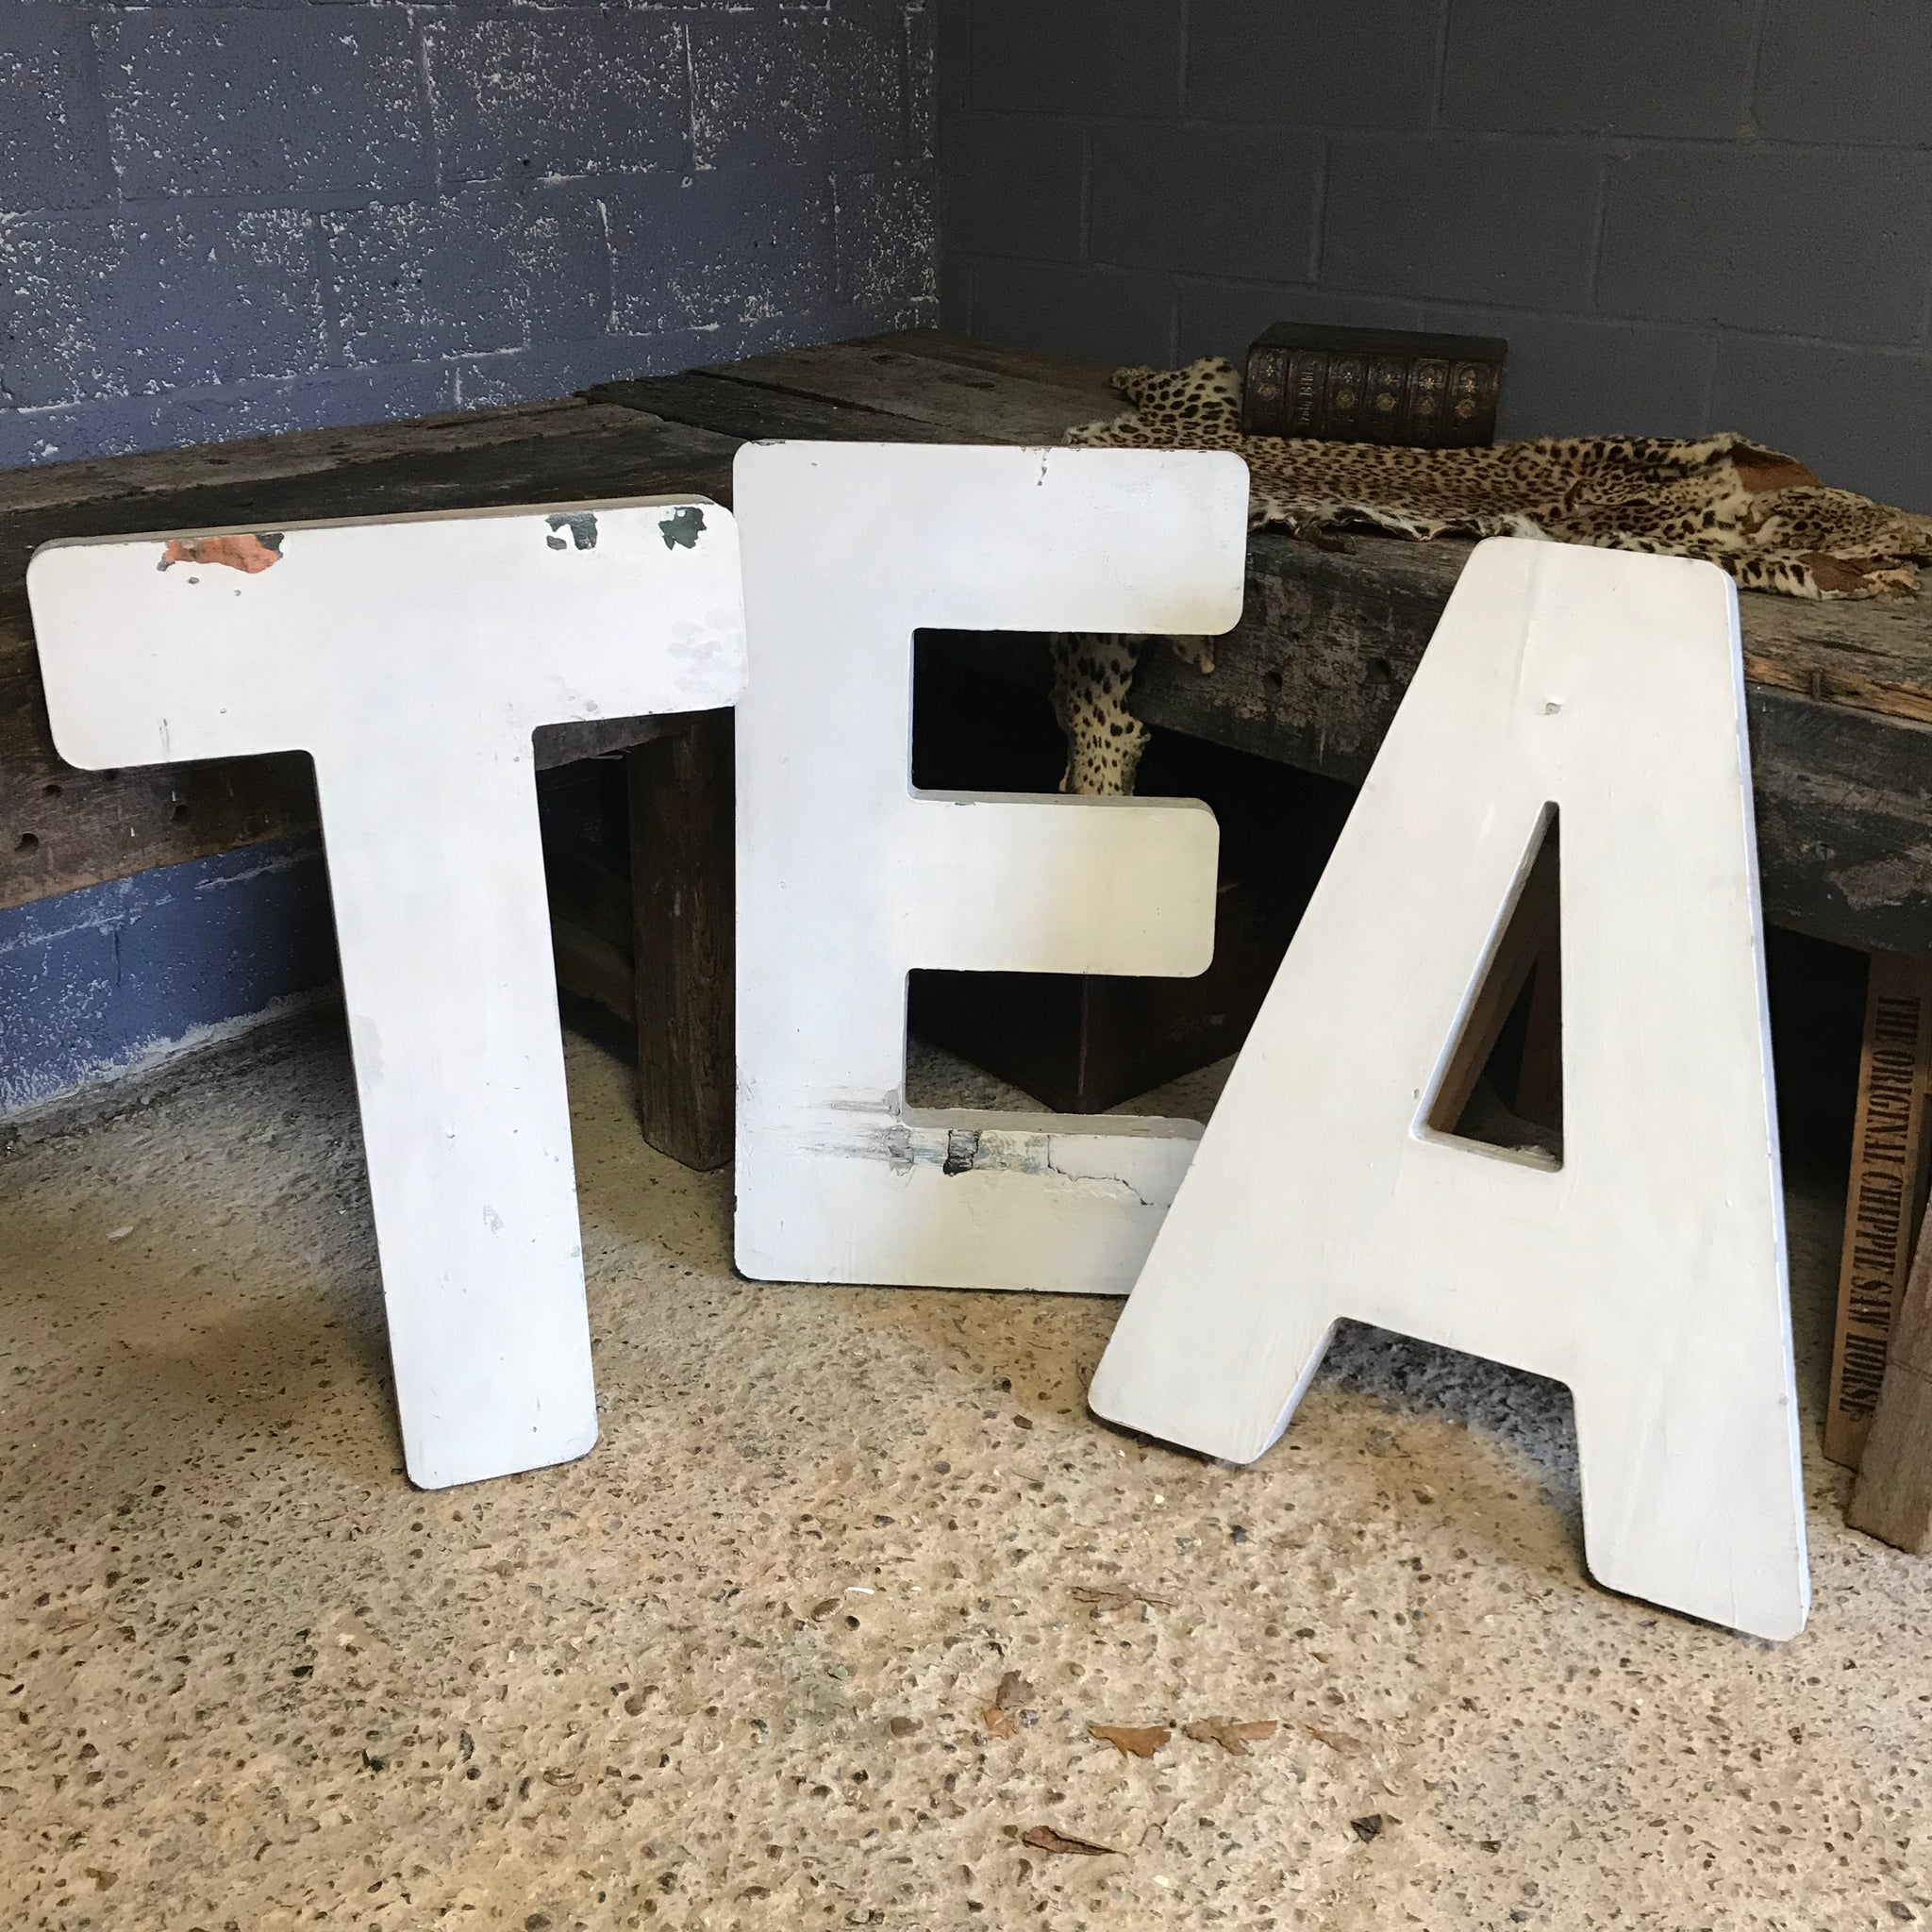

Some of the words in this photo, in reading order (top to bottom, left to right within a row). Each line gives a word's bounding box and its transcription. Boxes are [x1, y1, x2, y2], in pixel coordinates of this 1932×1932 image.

[26, 440, 1813, 1642] TEA
[1875, 995, 1921, 1045] THE
[1861, 1049, 1916, 1166] ORIGINAL
[1853, 1171, 1904, 1274] CHIPPIE
[1848, 1275, 1894, 1332] SAW
[1839, 1332, 1888, 1417] HORSE
